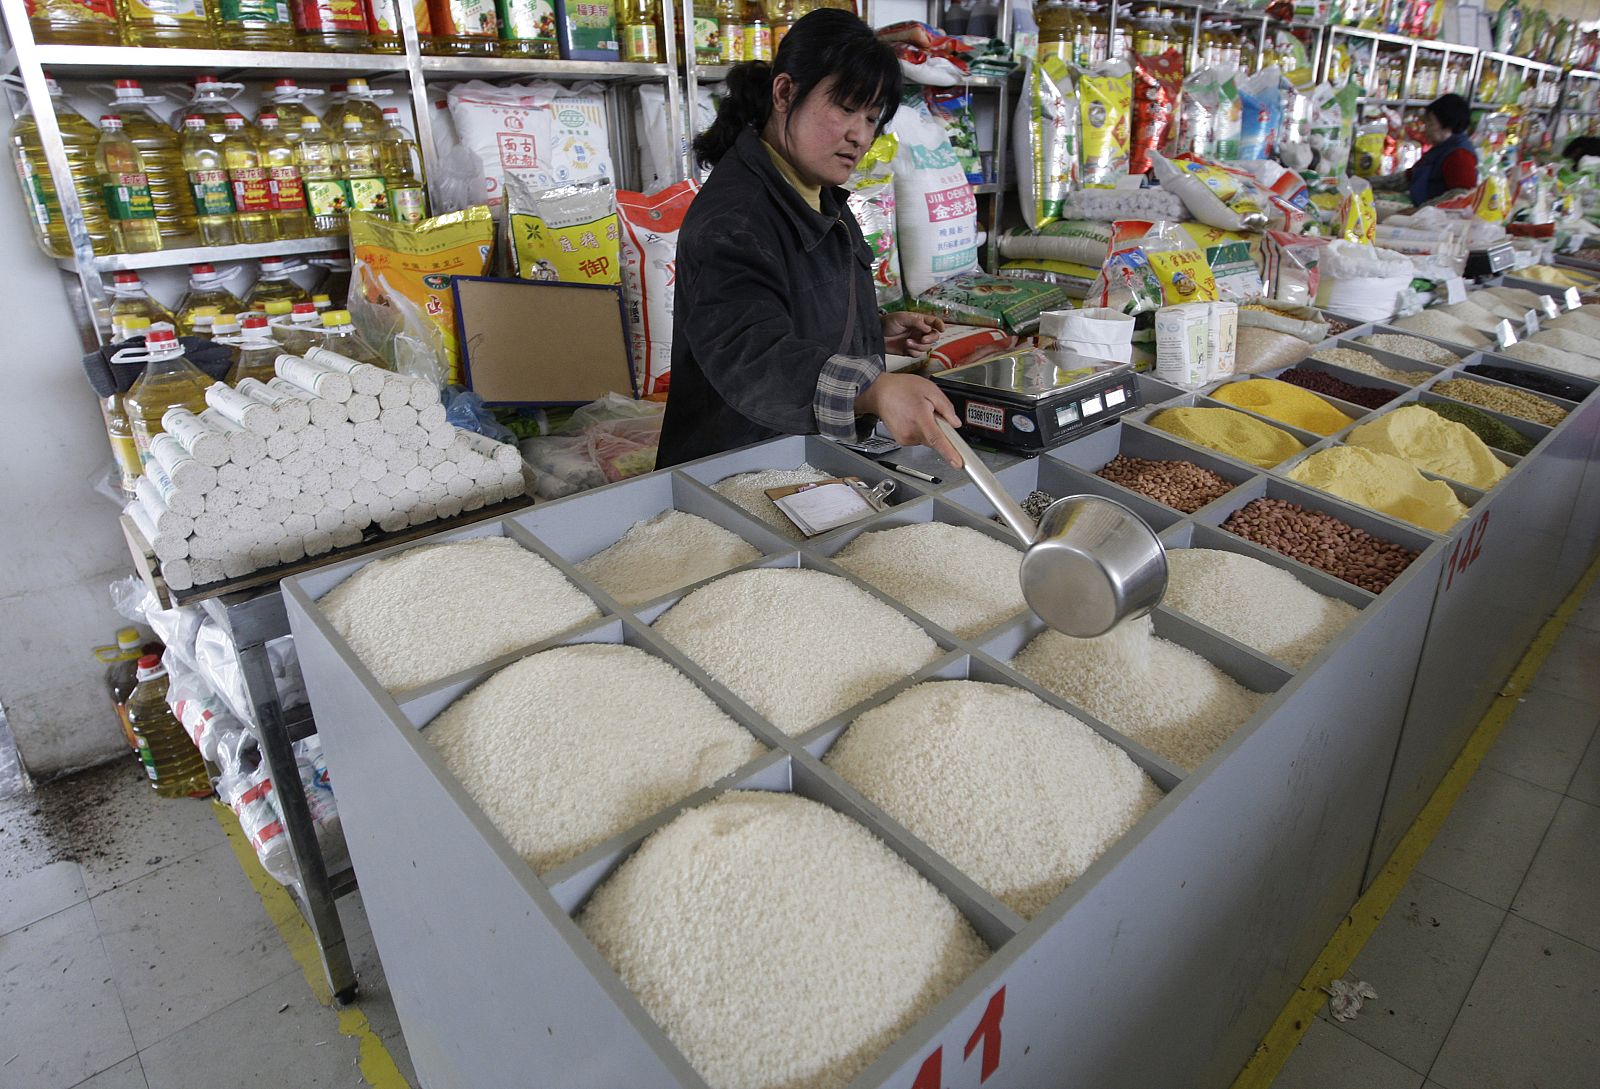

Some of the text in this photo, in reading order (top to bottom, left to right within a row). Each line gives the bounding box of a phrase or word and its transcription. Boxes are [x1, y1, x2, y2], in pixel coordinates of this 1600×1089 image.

[928, 191, 945, 204] JIN
[578, 256, 609, 278] 御
[968, 408, 1003, 426] 13366197185
[1445, 510, 1490, 592] 142
